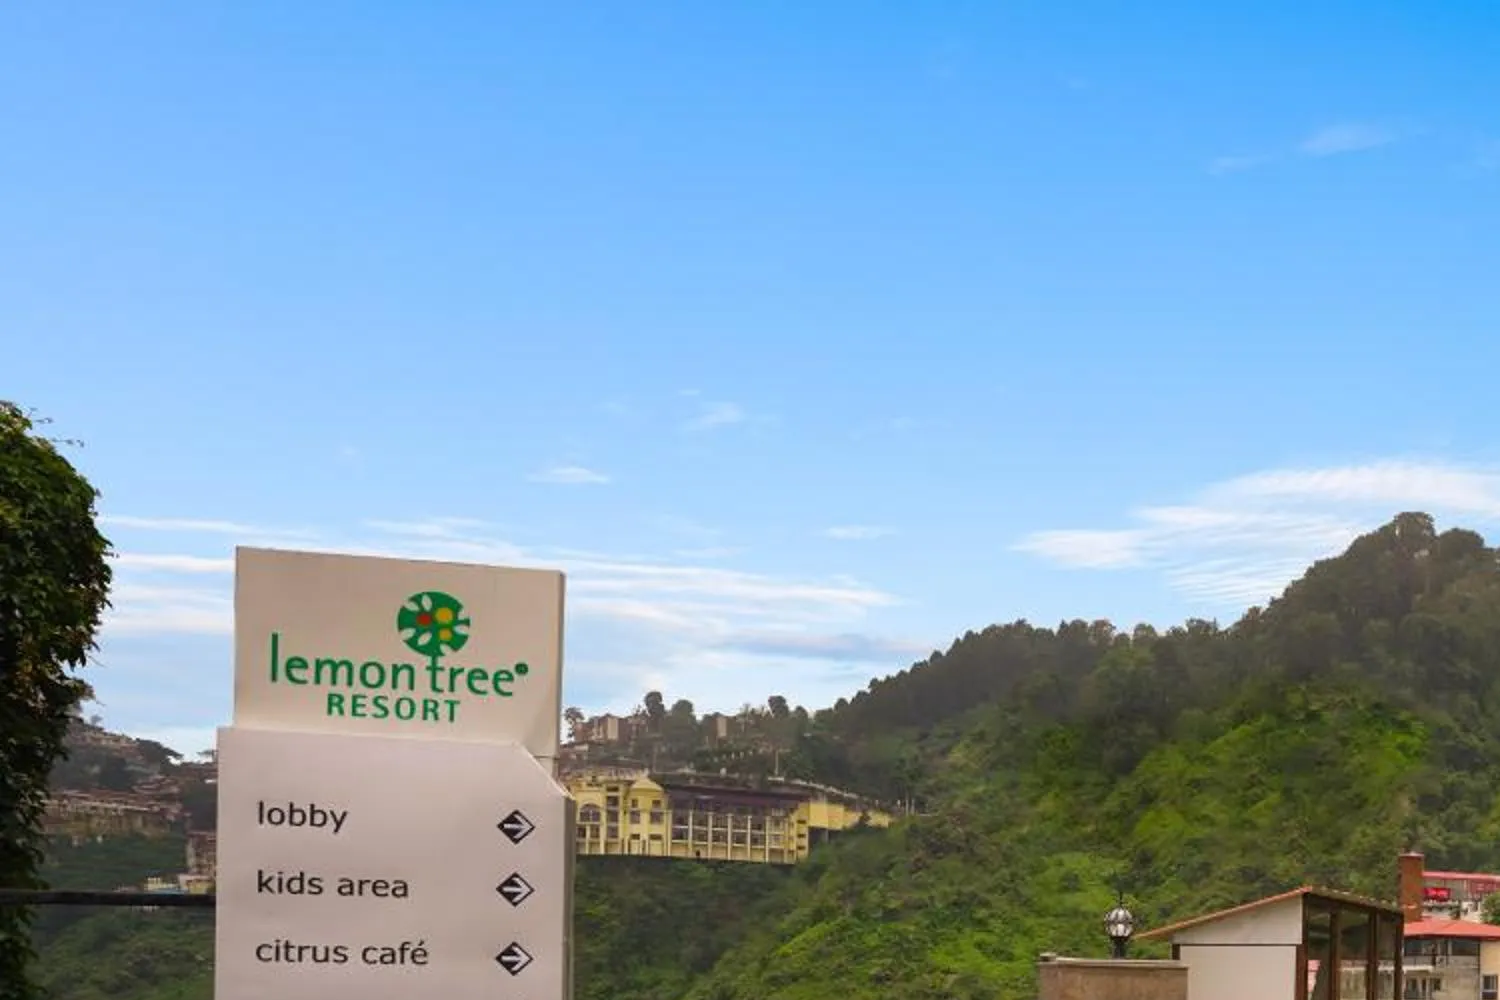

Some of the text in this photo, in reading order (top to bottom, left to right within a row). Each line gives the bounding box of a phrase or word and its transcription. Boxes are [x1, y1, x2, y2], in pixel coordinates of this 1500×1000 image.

[269, 632, 515, 697] lemon tree
[326, 692, 461, 722] RESORT
[257, 800, 348, 834] lobby
[256, 869, 410, 898] kids area
[254, 939, 430, 966] citrus café
